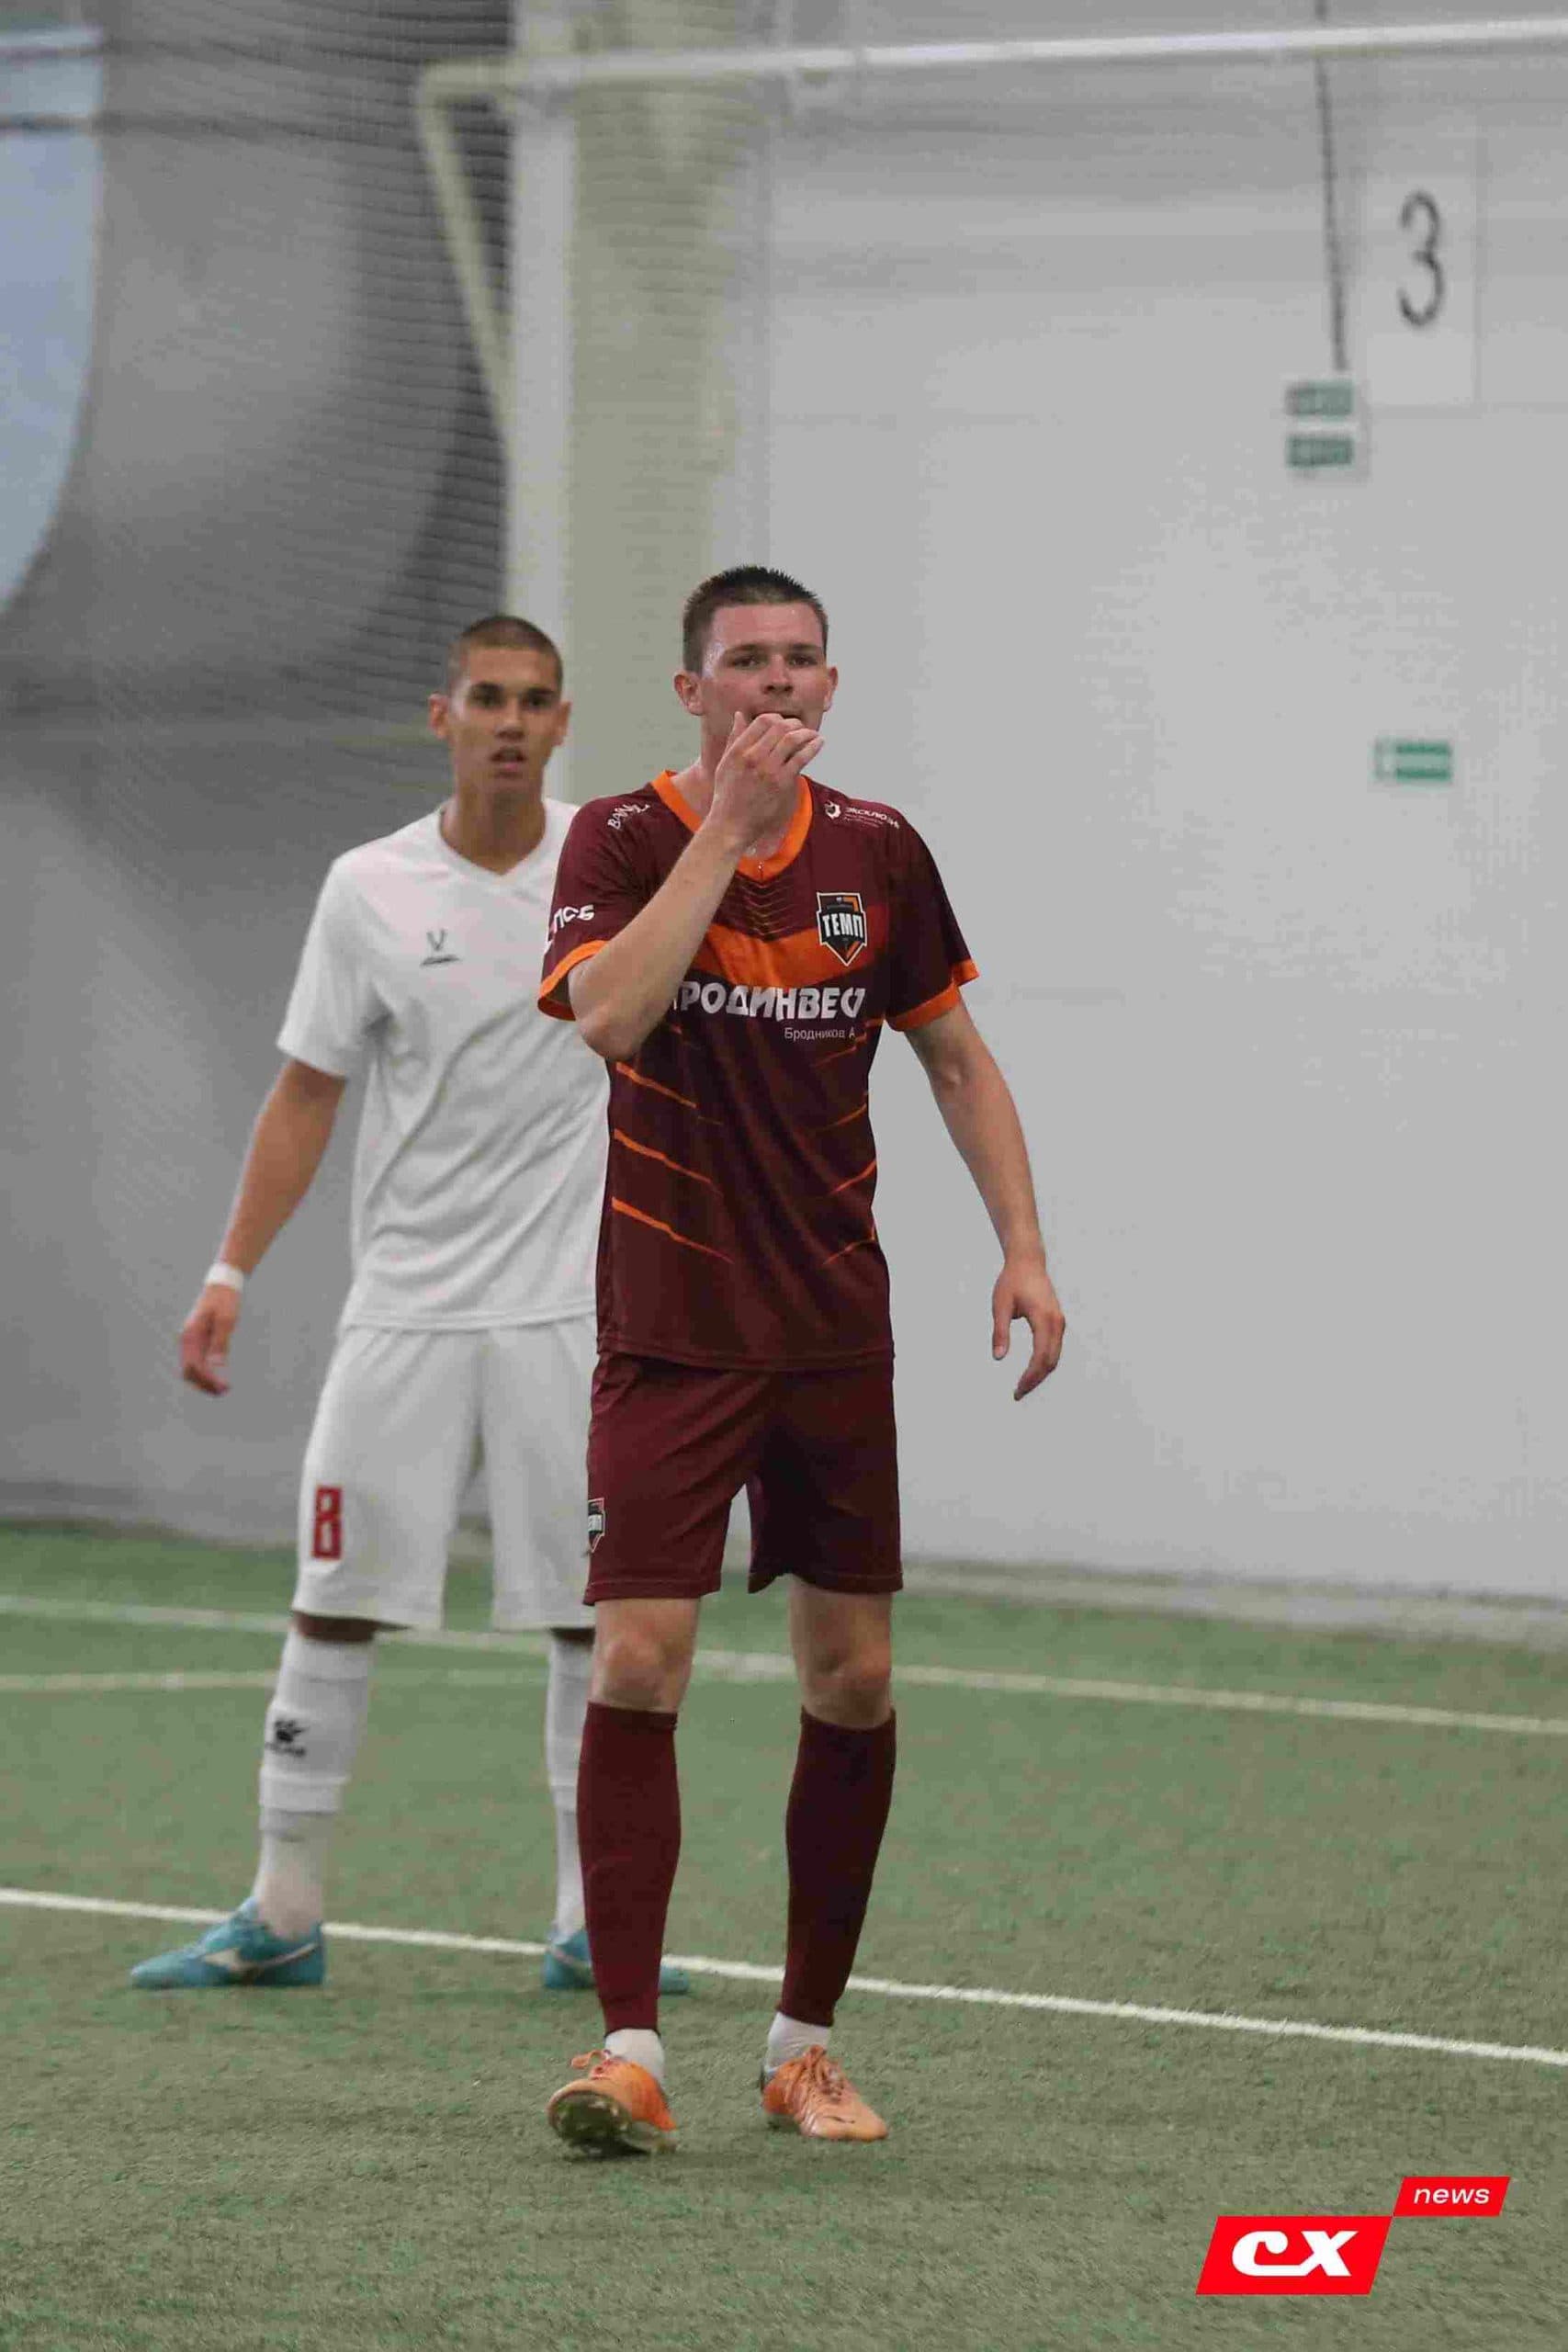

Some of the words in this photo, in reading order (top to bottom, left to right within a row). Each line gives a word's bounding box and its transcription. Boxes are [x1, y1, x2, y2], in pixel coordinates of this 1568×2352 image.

[1398, 189, 1446, 328] 3
[822, 912, 863, 938] ТЕМП
[673, 980, 866, 1022] РОДИНВЕСТ
[311, 1486, 342, 1560] 8
